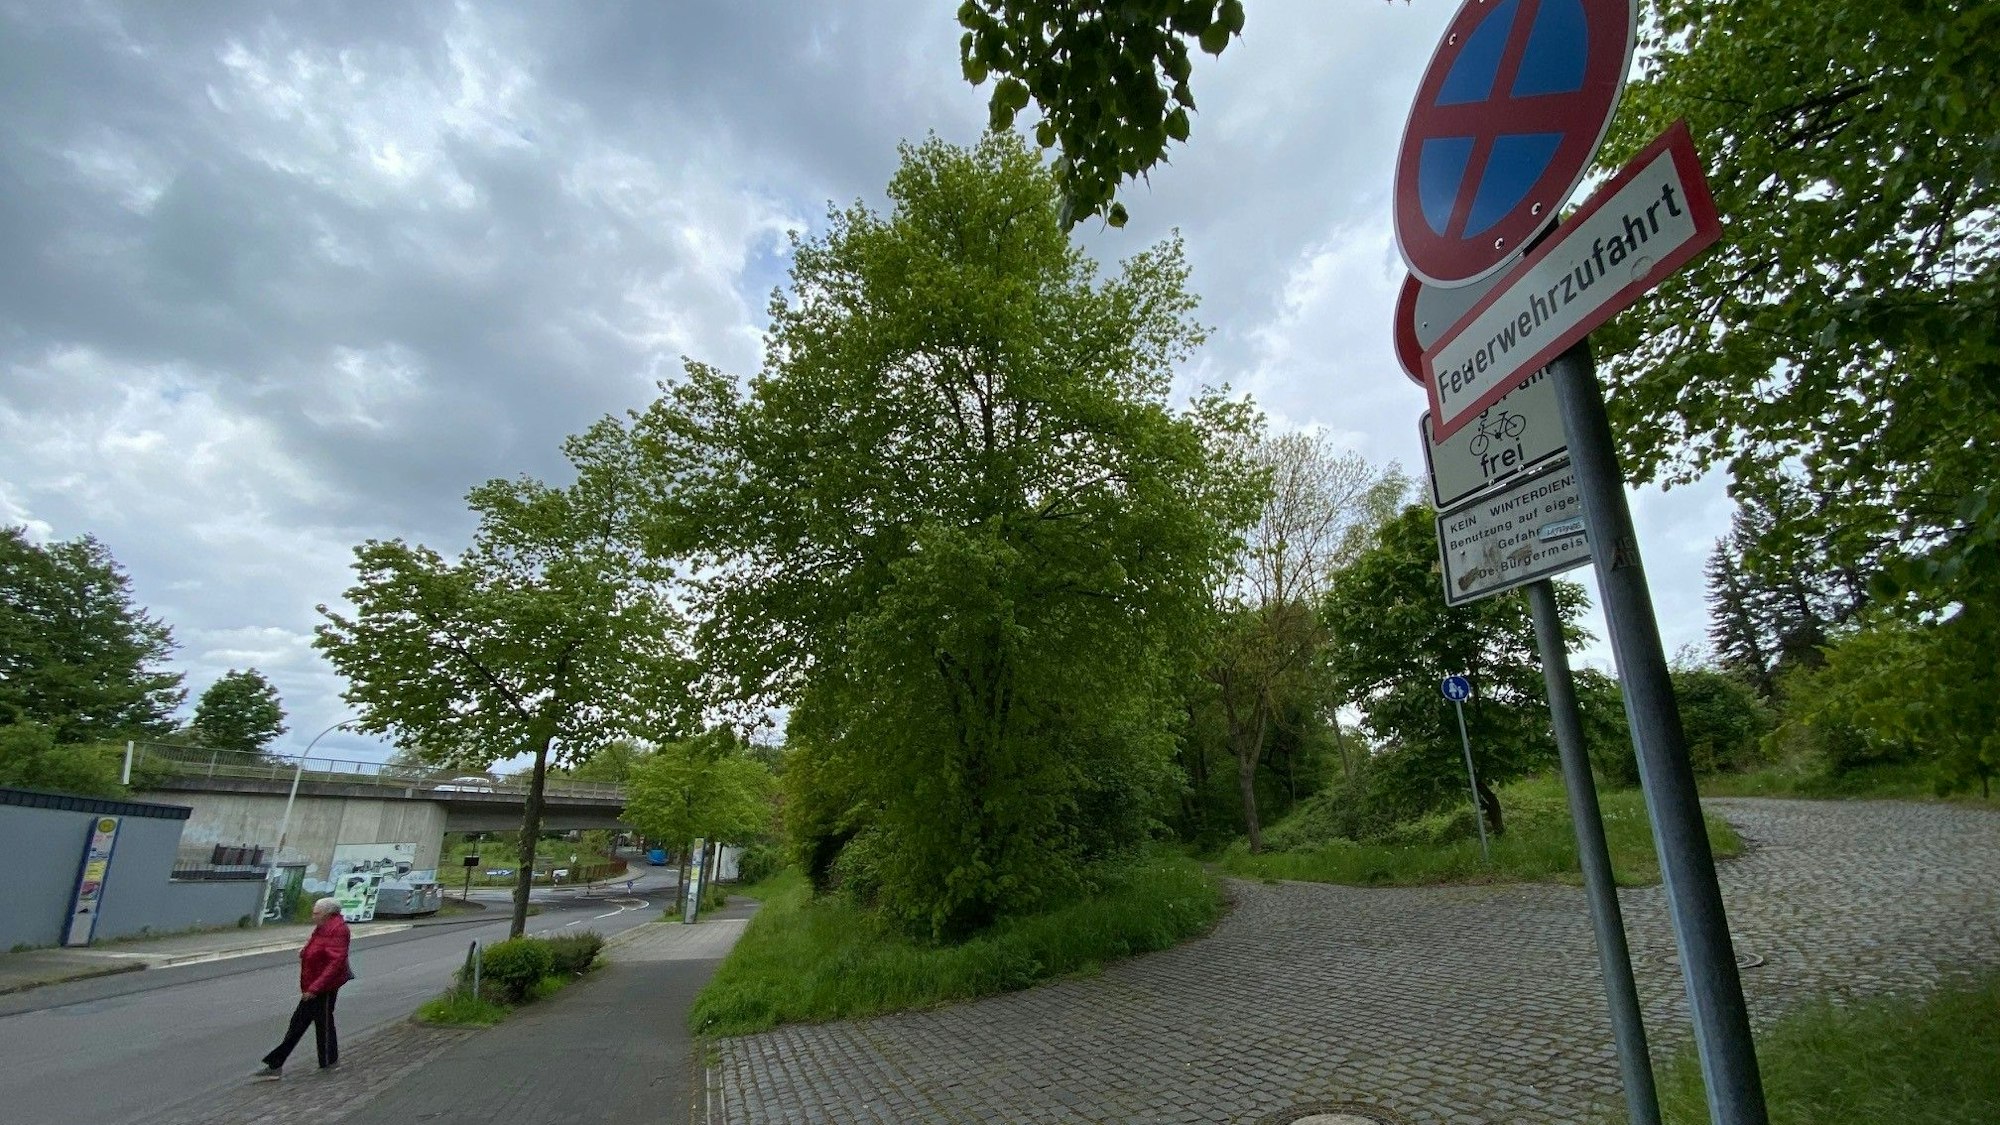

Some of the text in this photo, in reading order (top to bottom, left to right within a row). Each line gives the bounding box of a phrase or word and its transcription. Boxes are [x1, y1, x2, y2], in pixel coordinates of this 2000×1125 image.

[1438, 182, 1681, 403] Feuerwehrzufahrt
[1480, 437, 1524, 477] frei
[1450, 515, 1477, 534] KEIN
[1450, 520, 1513, 550] Benutzung
[1518, 508, 1539, 523] auf
[1479, 565, 1500, 579] De
